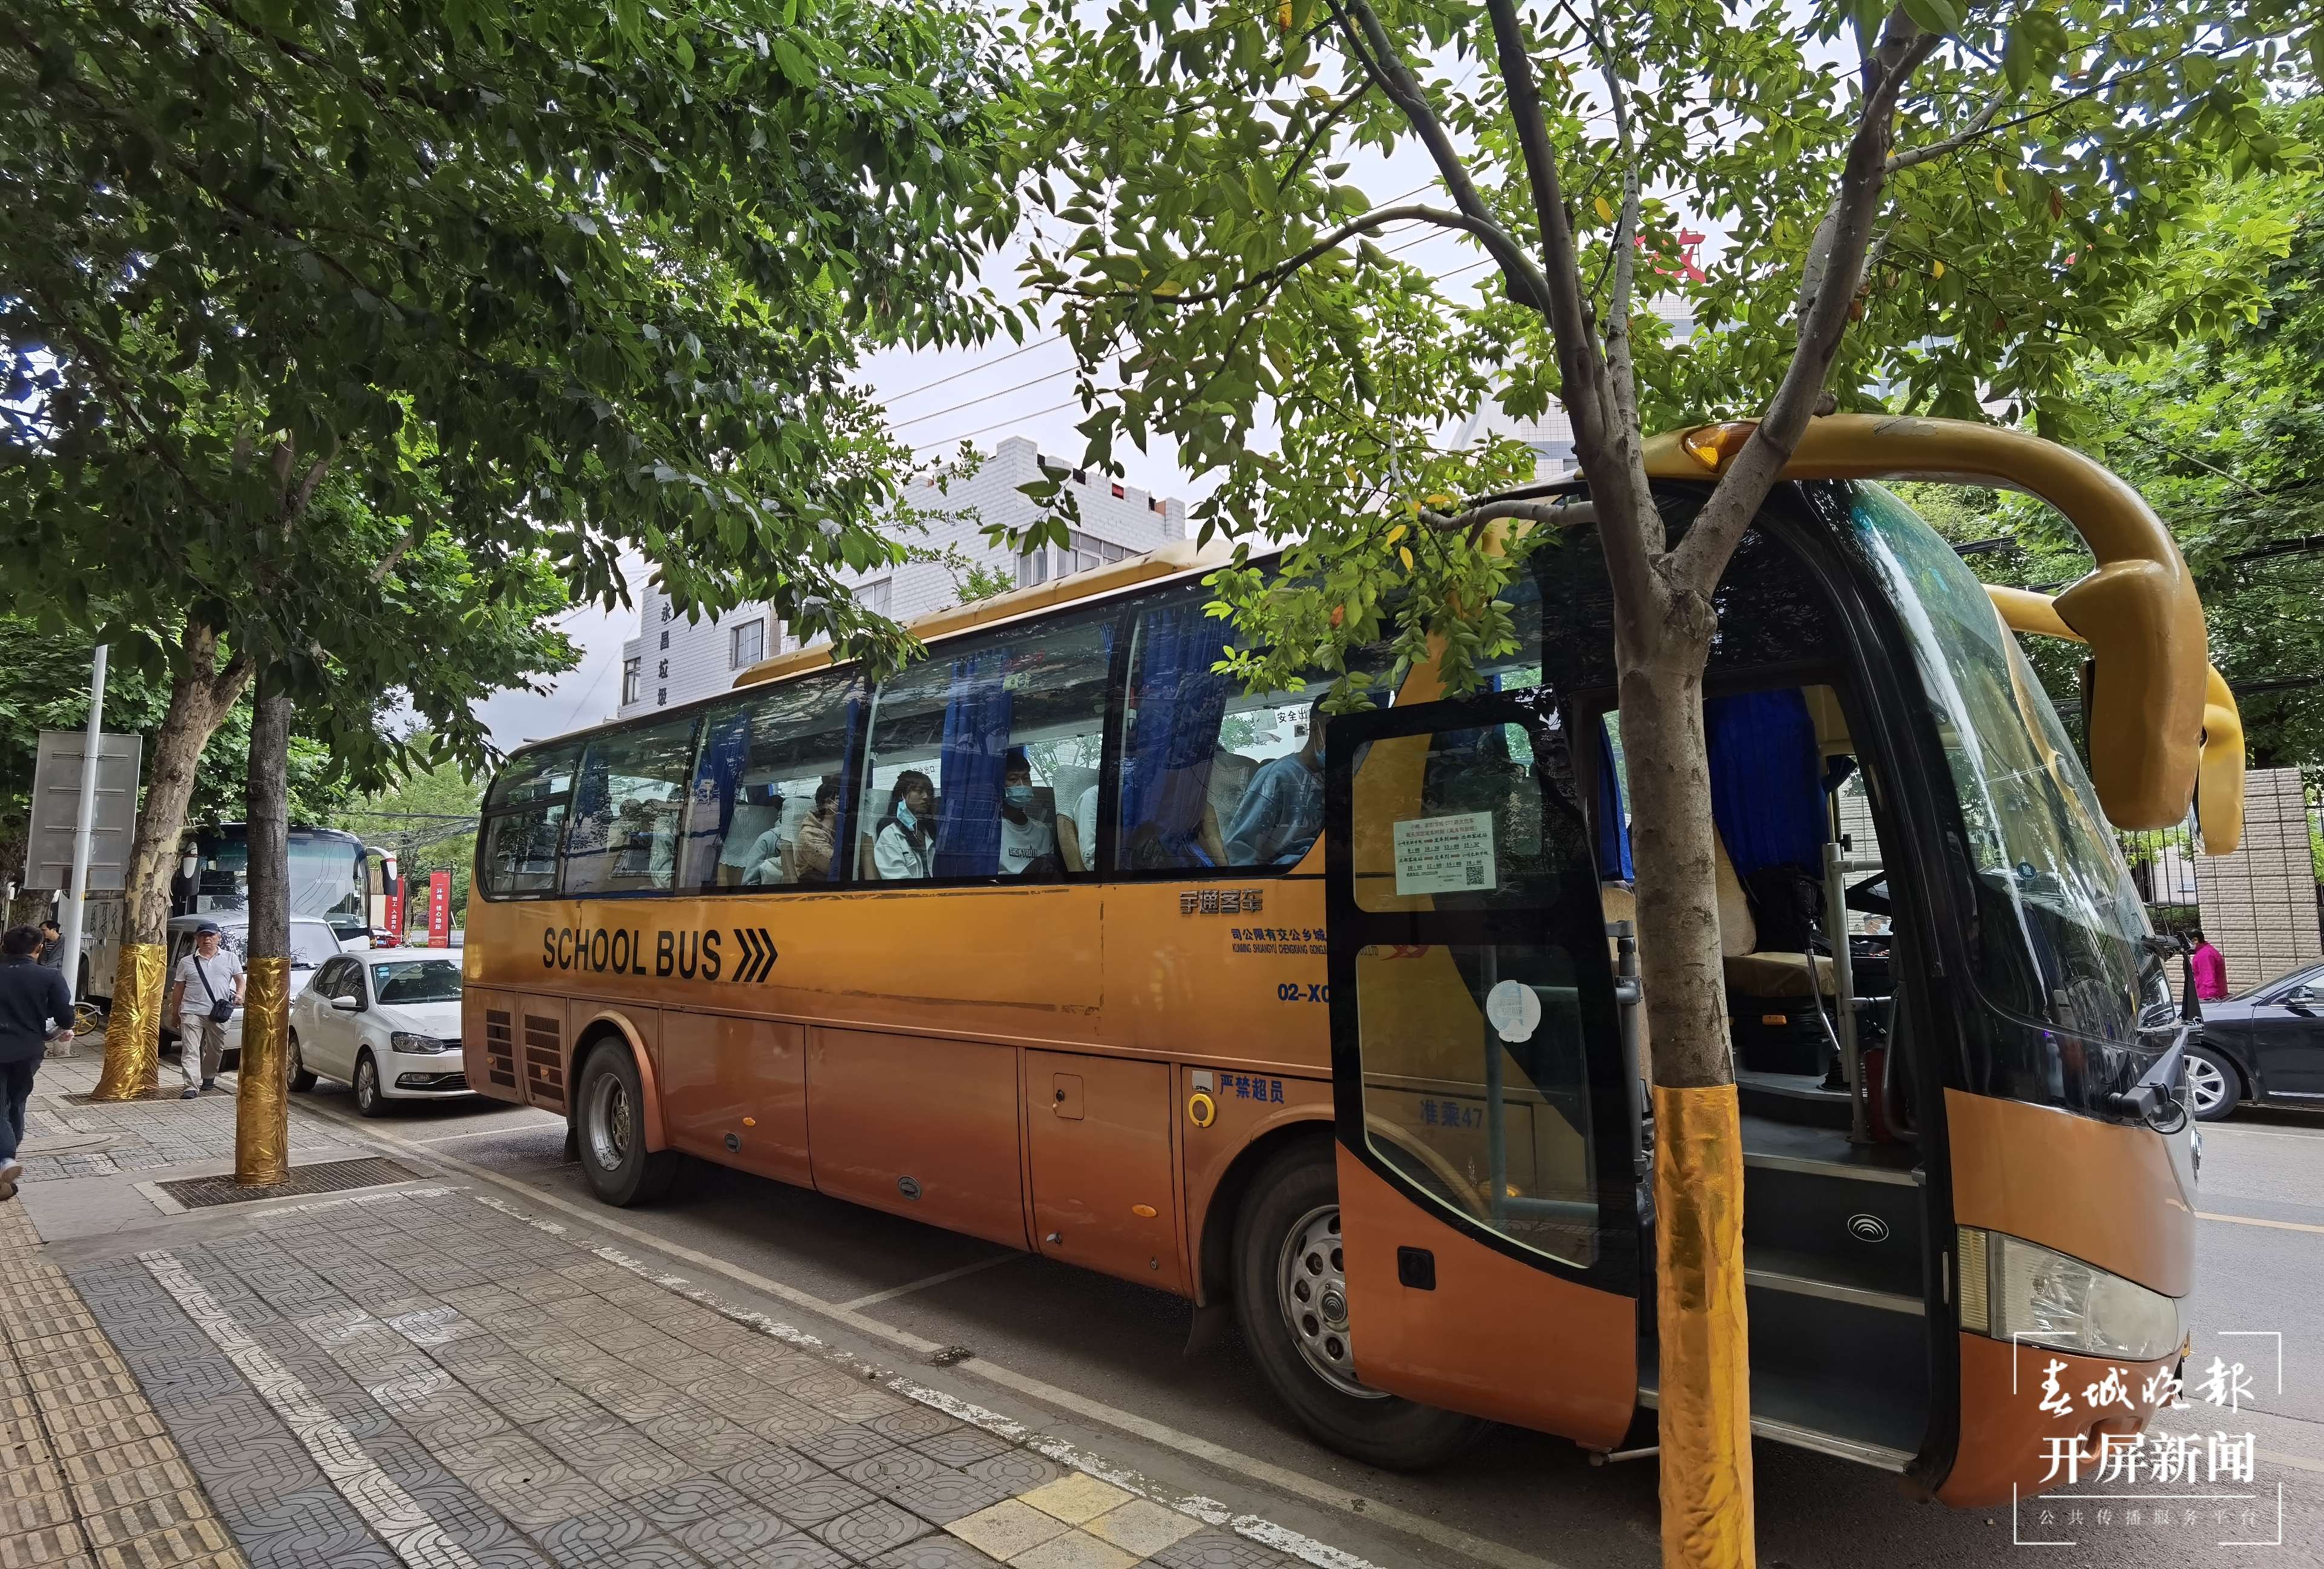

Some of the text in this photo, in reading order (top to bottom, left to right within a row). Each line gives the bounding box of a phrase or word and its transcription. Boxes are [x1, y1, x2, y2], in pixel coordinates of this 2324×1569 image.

[657, 602, 671, 706] 永昌垃圾
[1277, 707, 1310, 723] 安全出
[1180, 888, 1263, 915] 宇通客车
[542, 927, 721, 981] SCHOOL BUS
[1220, 1074, 1284, 1104] 严禁超员
[1420, 1099, 1483, 1128] 准乘47
